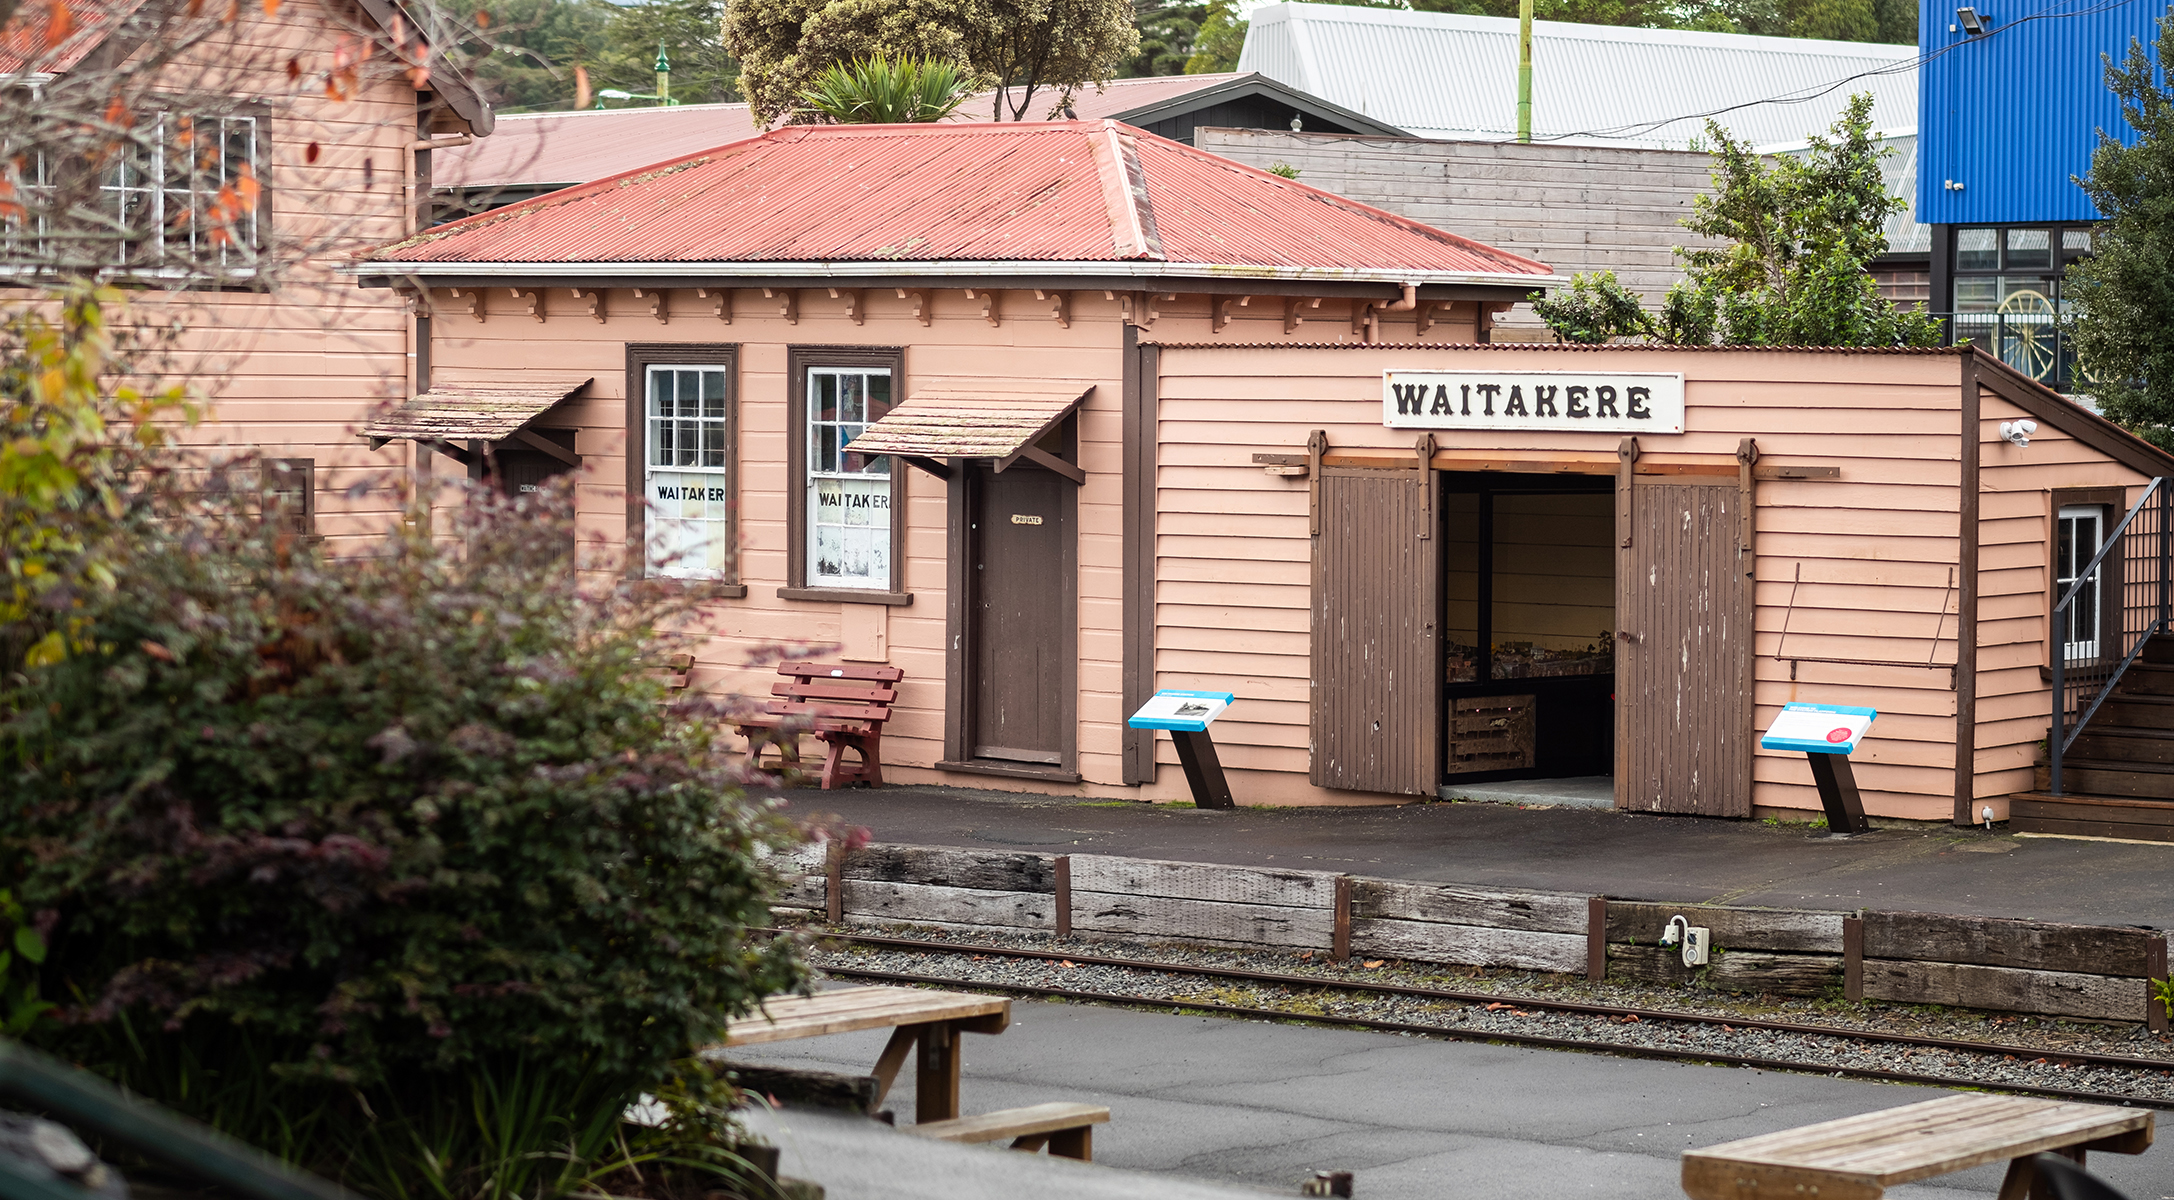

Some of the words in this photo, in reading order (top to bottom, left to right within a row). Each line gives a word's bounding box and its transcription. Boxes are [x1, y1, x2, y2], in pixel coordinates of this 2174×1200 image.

[1391, 383, 1652, 419] WAITAKERE
[819, 492, 890, 509] WAITAKER
[1015, 516, 1040, 524] PRIVATE
